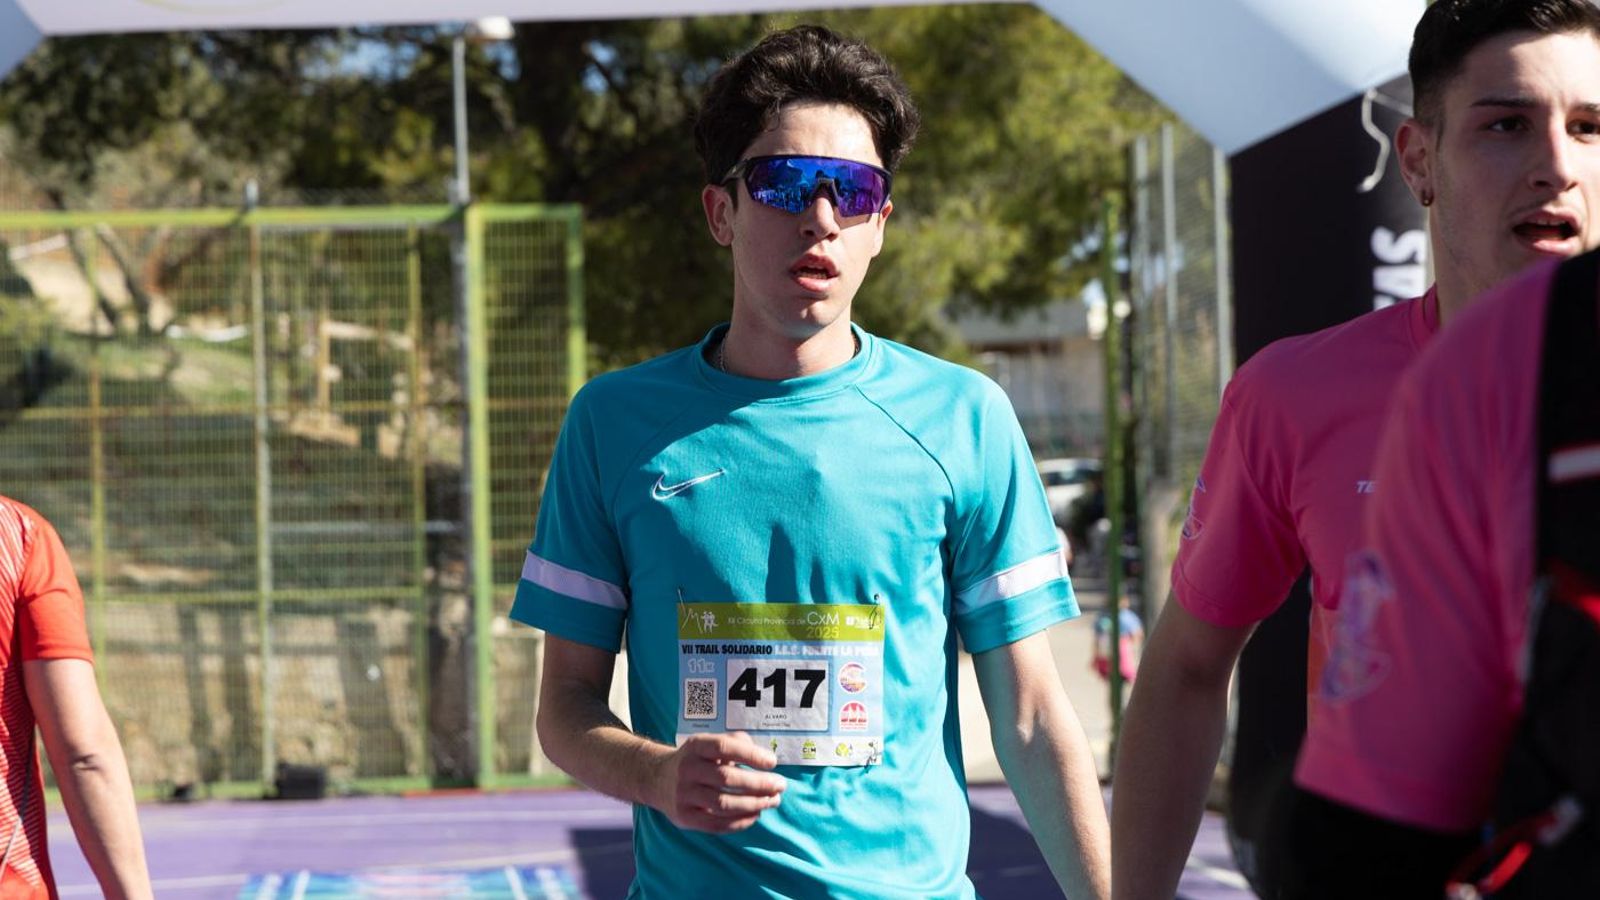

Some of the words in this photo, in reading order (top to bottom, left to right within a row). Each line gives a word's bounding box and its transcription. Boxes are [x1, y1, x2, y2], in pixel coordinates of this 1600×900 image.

[1371, 226, 1427, 312] AS
[807, 611, 840, 626] CxM
[806, 626, 840, 639] 2025
[682, 644, 694, 655] VII
[695, 644, 720, 655] TRAIL
[721, 644, 773, 655] SOLIDARIO
[728, 667, 826, 709] 417
